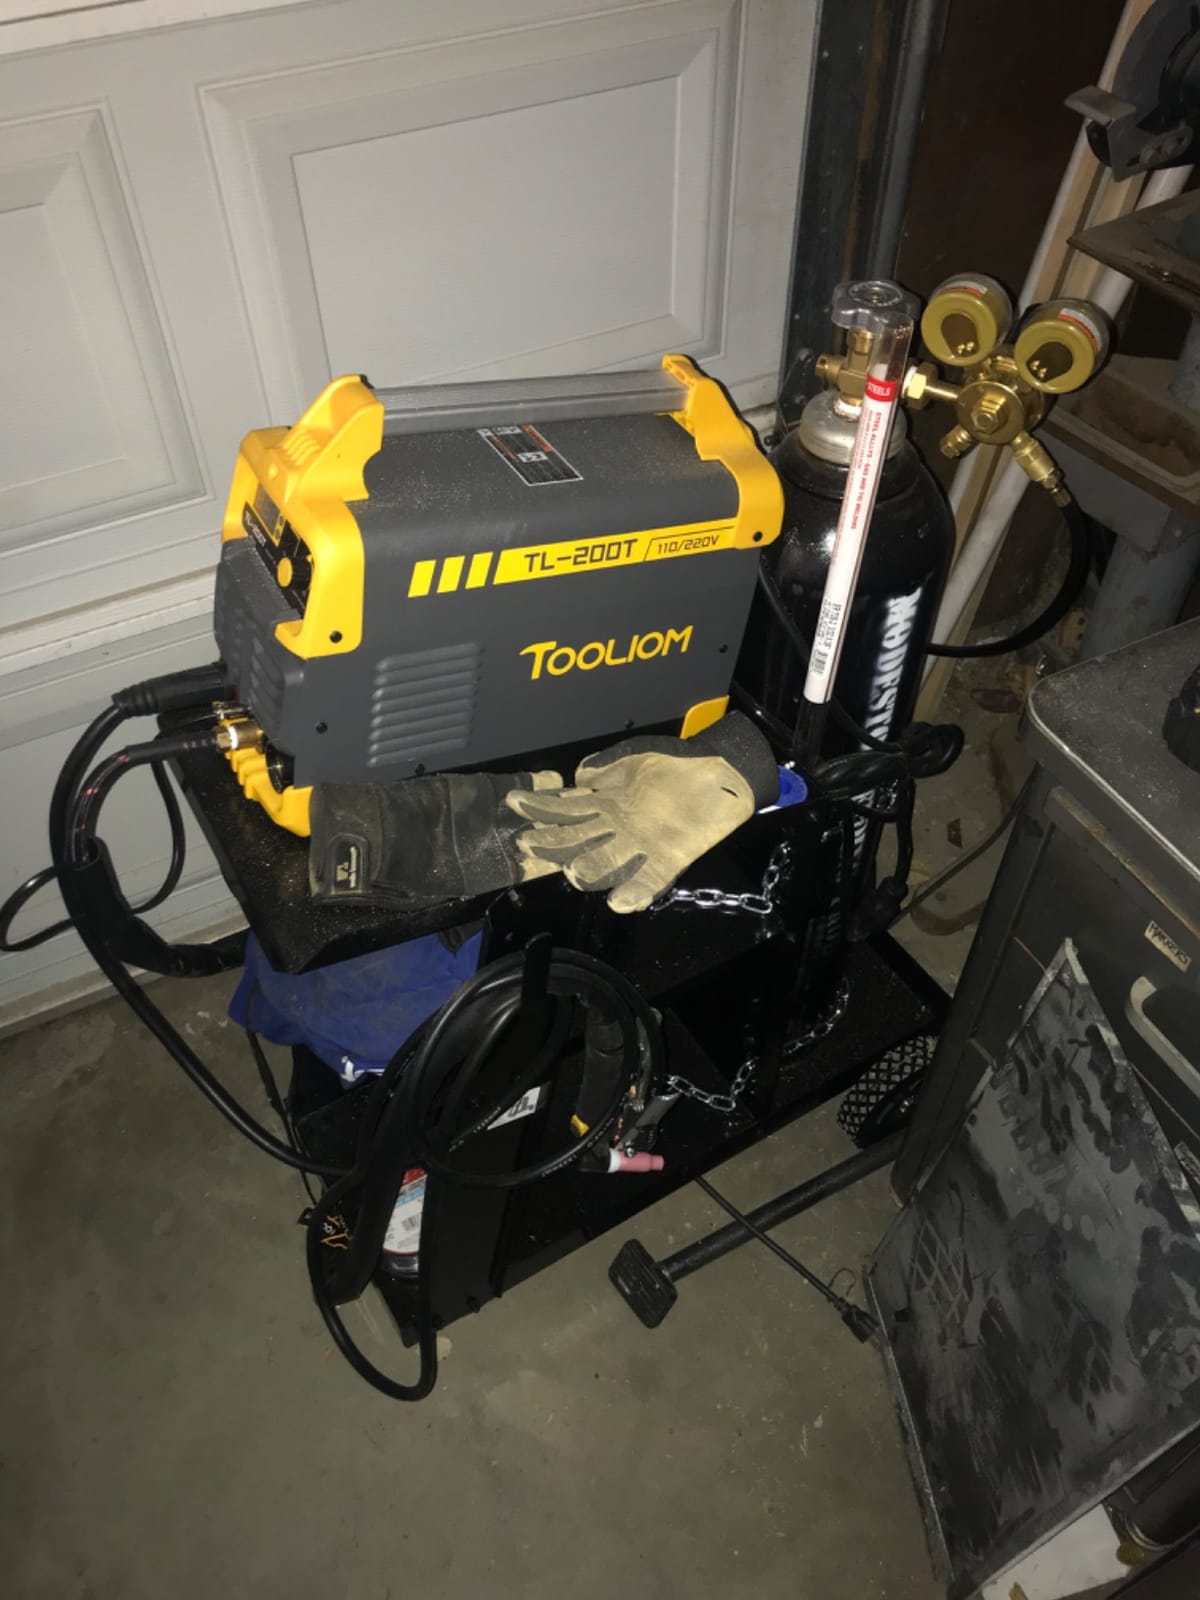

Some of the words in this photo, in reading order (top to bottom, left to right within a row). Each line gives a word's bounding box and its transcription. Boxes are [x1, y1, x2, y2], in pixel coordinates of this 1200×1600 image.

[872, 411, 882, 432] STEEL
[524, 538, 638, 573] TL-200T
[657, 535, 720, 555] 110/220V
[519, 625, 694, 680] TOOLIOM
